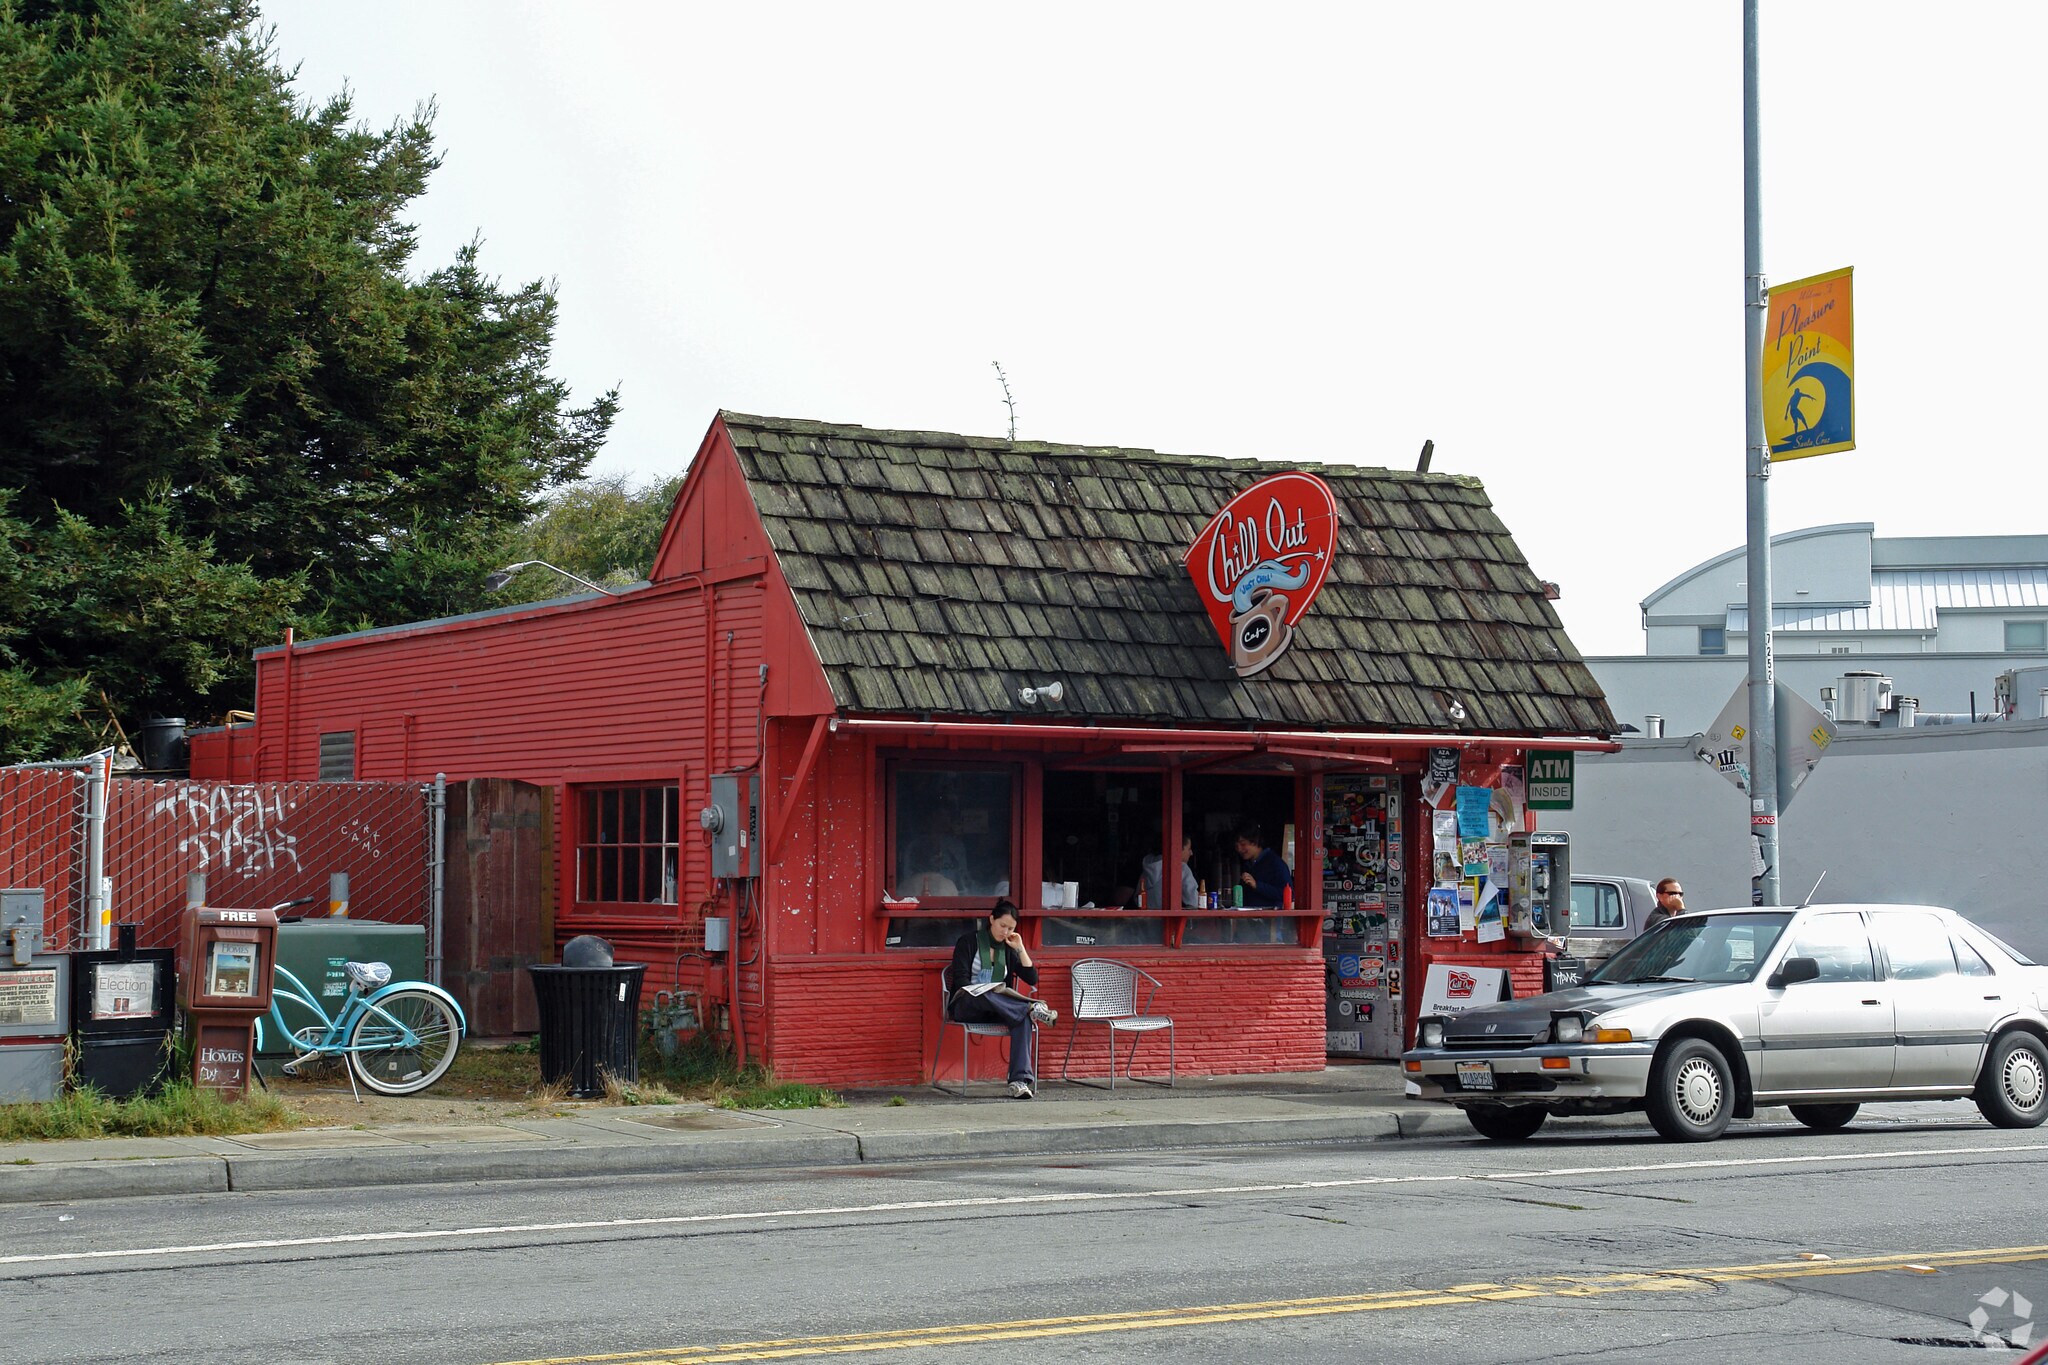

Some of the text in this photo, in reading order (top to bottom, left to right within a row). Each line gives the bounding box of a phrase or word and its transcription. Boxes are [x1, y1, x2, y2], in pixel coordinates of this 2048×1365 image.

[1777, 299, 1835, 351] Pleasure
[1786, 334, 1822, 379] Point
[1793, 432, 1830, 449] Santa Cruz
[1208, 496, 1308, 603] Chill Out
[1765, 632, 1773, 682] 7252
[1531, 760, 1570, 779] ATM
[1531, 786, 1568, 797] INSIDE
[220, 911, 257, 922] FREE
[221, 943, 249, 954] HOMES
[99, 976, 147, 991] Election
[1432, 1003, 1460, 1012] Breakfast
[201, 1047, 244, 1063] HOMES
